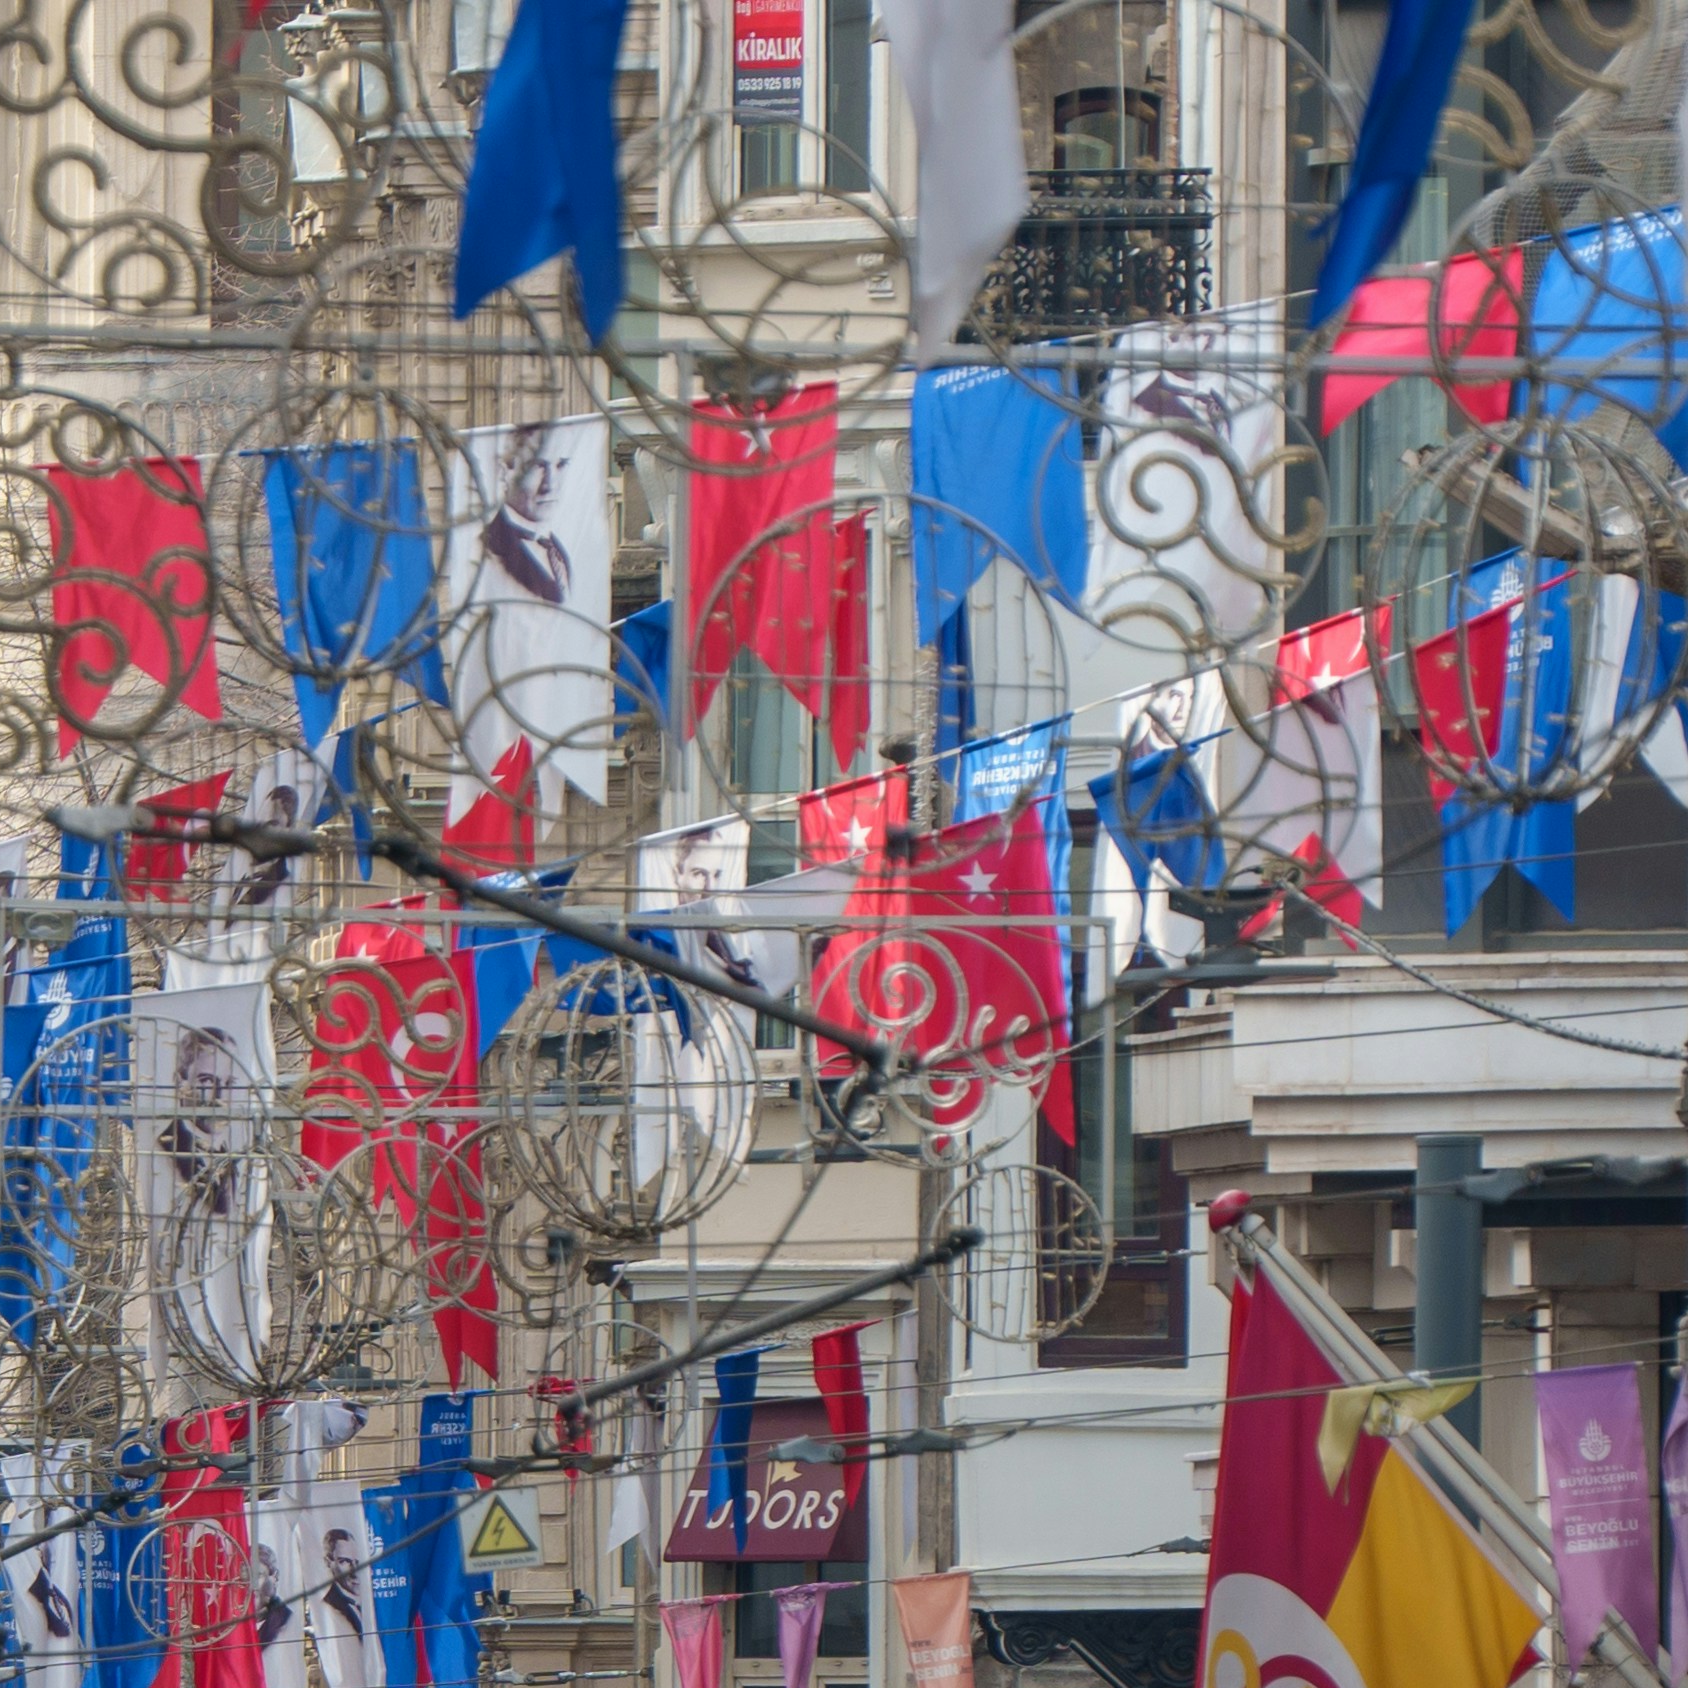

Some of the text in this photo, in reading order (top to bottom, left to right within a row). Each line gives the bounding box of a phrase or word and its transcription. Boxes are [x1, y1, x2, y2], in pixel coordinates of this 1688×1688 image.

[738, 32, 801, 61] KİRALIK
[738, 78, 763, 91] 0533
[1559, 1472, 1639, 1489] BÜYÜKŞEHİR
[1565, 1517, 1639, 1537] BEYOĞLU
